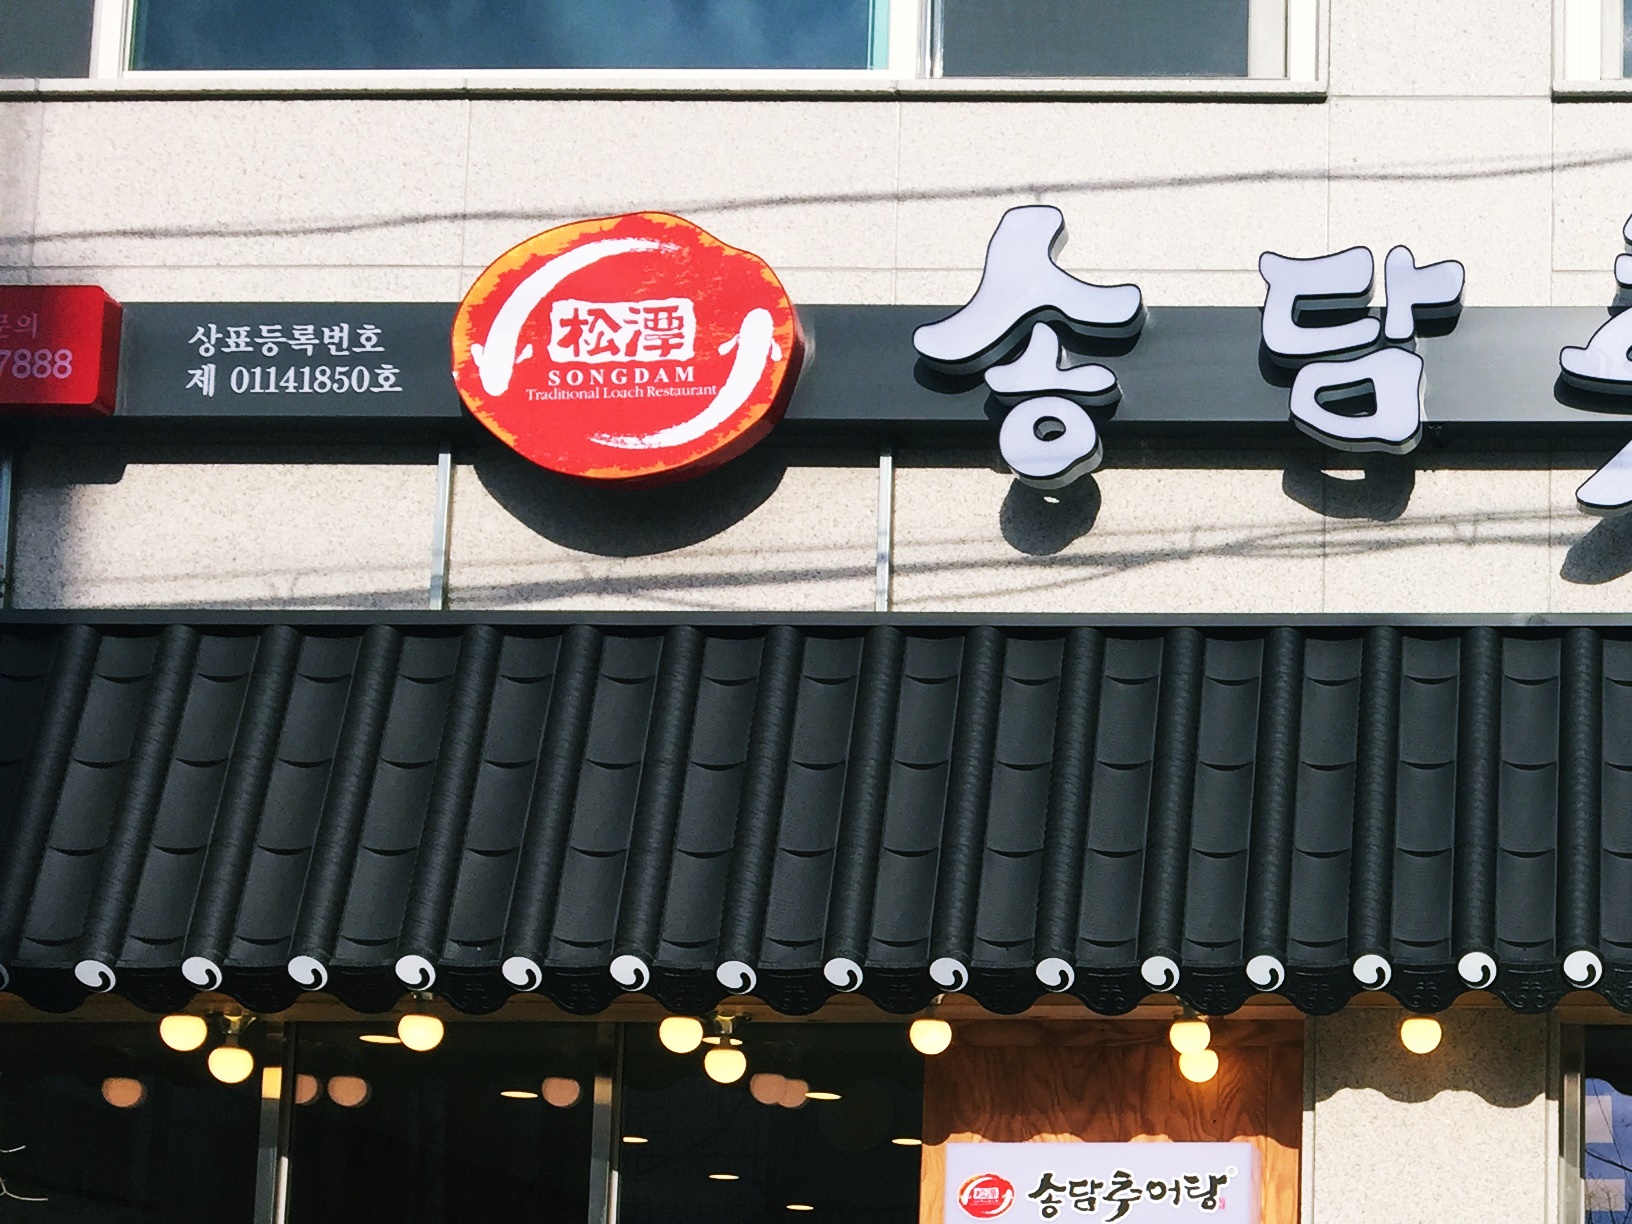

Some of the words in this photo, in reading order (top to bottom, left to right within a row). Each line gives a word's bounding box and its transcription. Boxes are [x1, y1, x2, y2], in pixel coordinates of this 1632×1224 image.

[187, 322, 386, 358] 상표등록번호
[0, 348, 73, 379] 7888
[185, 362, 217, 398] 제
[229, 362, 404, 394] 01141850호
[547, 365, 696, 387] SONGDAM
[525, 385, 600, 401] Traditional
[602, 385, 644, 400] Loach
[648, 384, 718, 398] Restaurant
[1027, 1169, 1228, 1223] 송담추어탕
